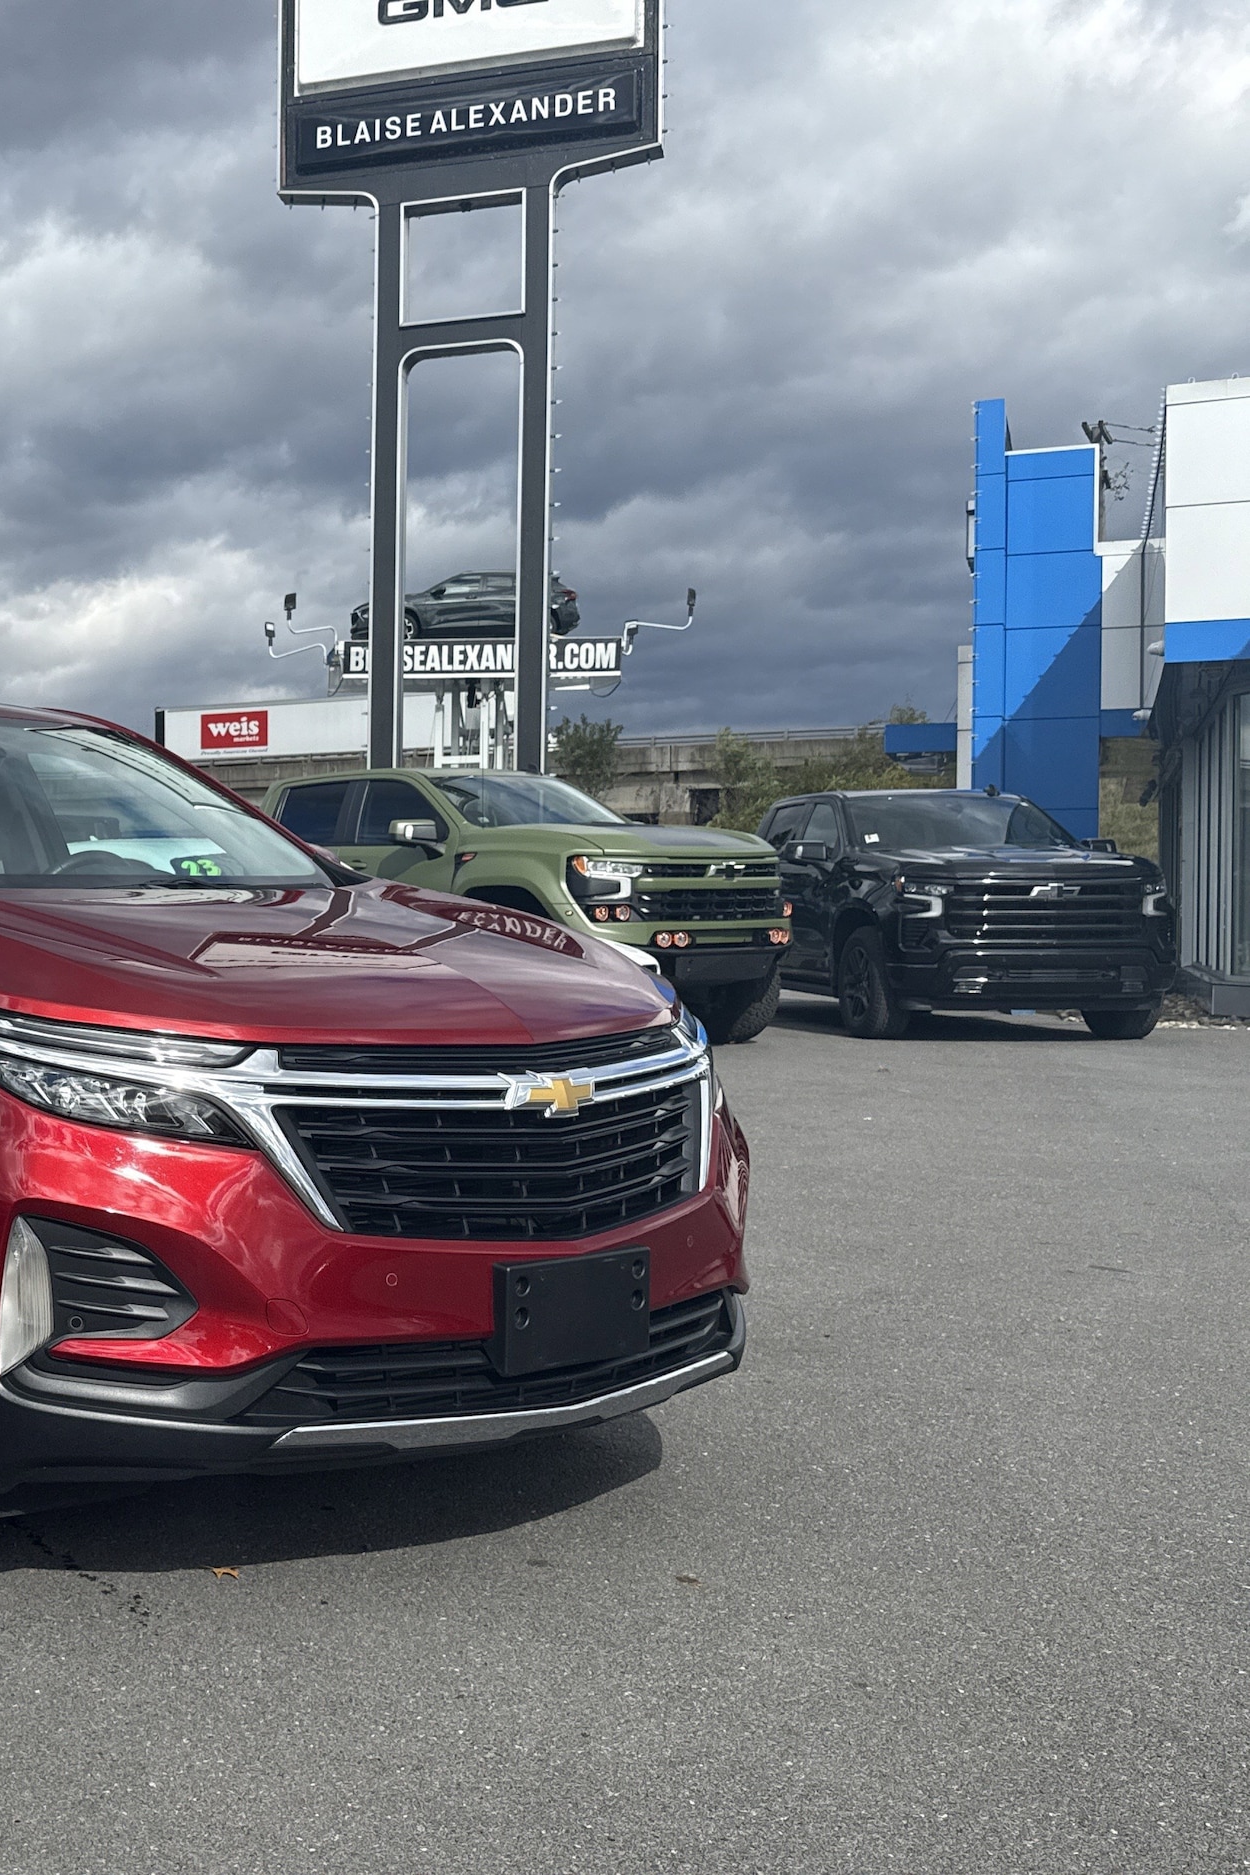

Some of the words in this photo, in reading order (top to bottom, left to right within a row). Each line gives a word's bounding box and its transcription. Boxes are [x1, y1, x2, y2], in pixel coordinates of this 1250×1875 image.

[316, 113, 422, 149] BLAISE
[430, 88, 617, 135] ALEXANDER
[207, 716, 259, 737] weis
